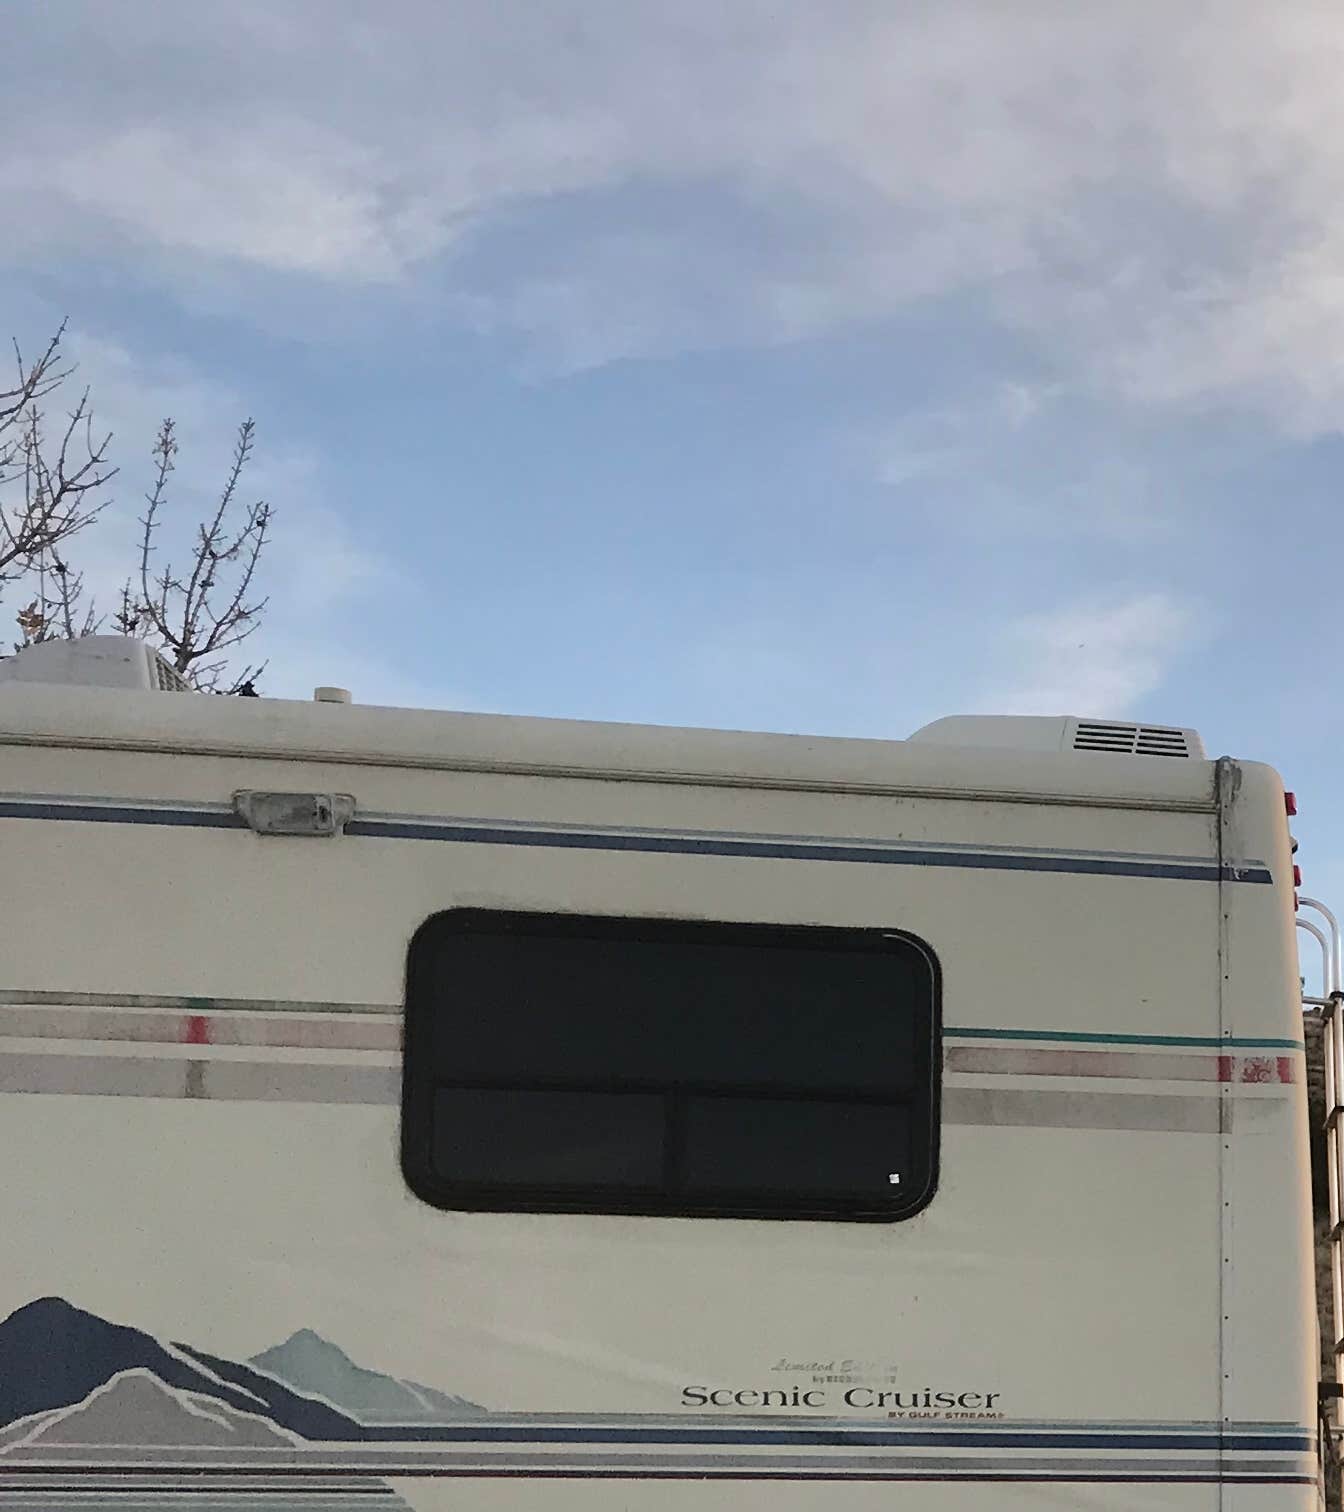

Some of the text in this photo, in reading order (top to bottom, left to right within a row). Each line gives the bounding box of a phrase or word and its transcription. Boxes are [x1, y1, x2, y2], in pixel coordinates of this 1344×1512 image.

[680, 1385, 1001, 1410] Scenic Cruiser
[887, 1411, 906, 1419] BY
[908, 1411, 942, 1420] GULF
